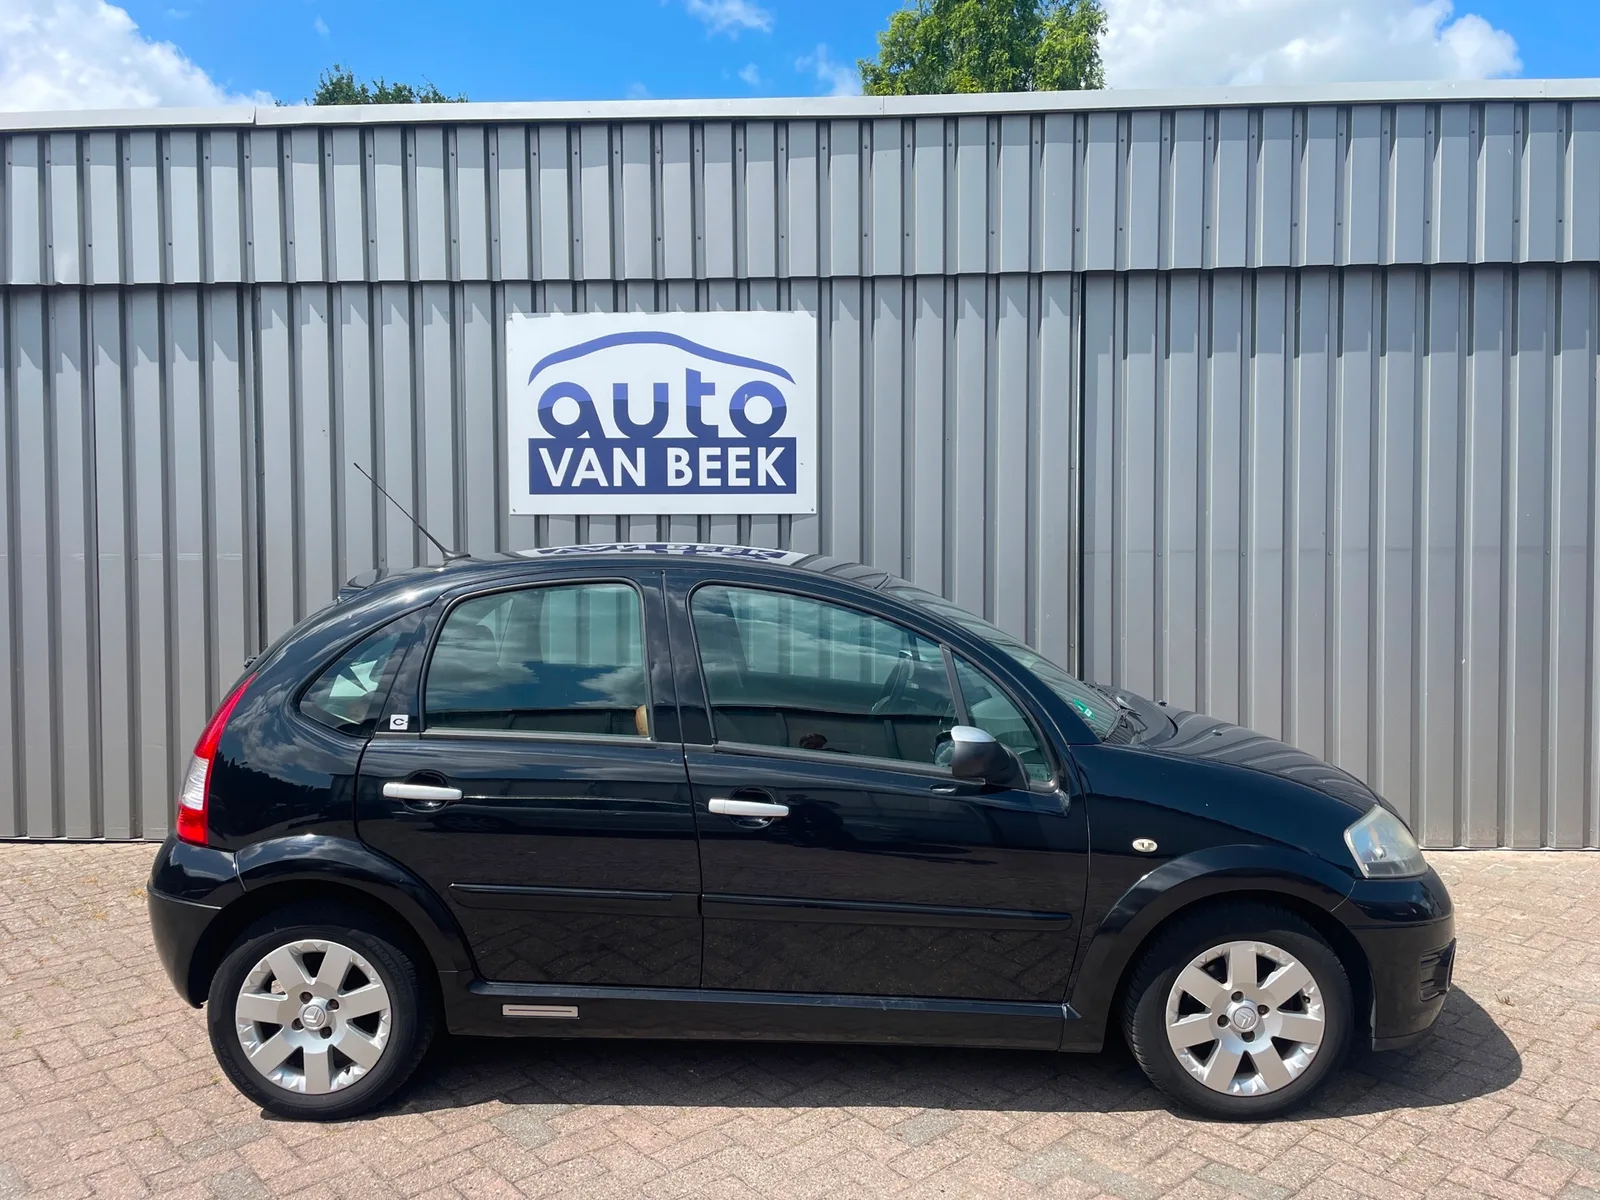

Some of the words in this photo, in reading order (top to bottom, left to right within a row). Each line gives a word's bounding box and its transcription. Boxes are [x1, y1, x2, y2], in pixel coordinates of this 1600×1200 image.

[538, 368, 787, 438] auto
[539, 448, 646, 487] VAN
[667, 447, 787, 487] BEEK
